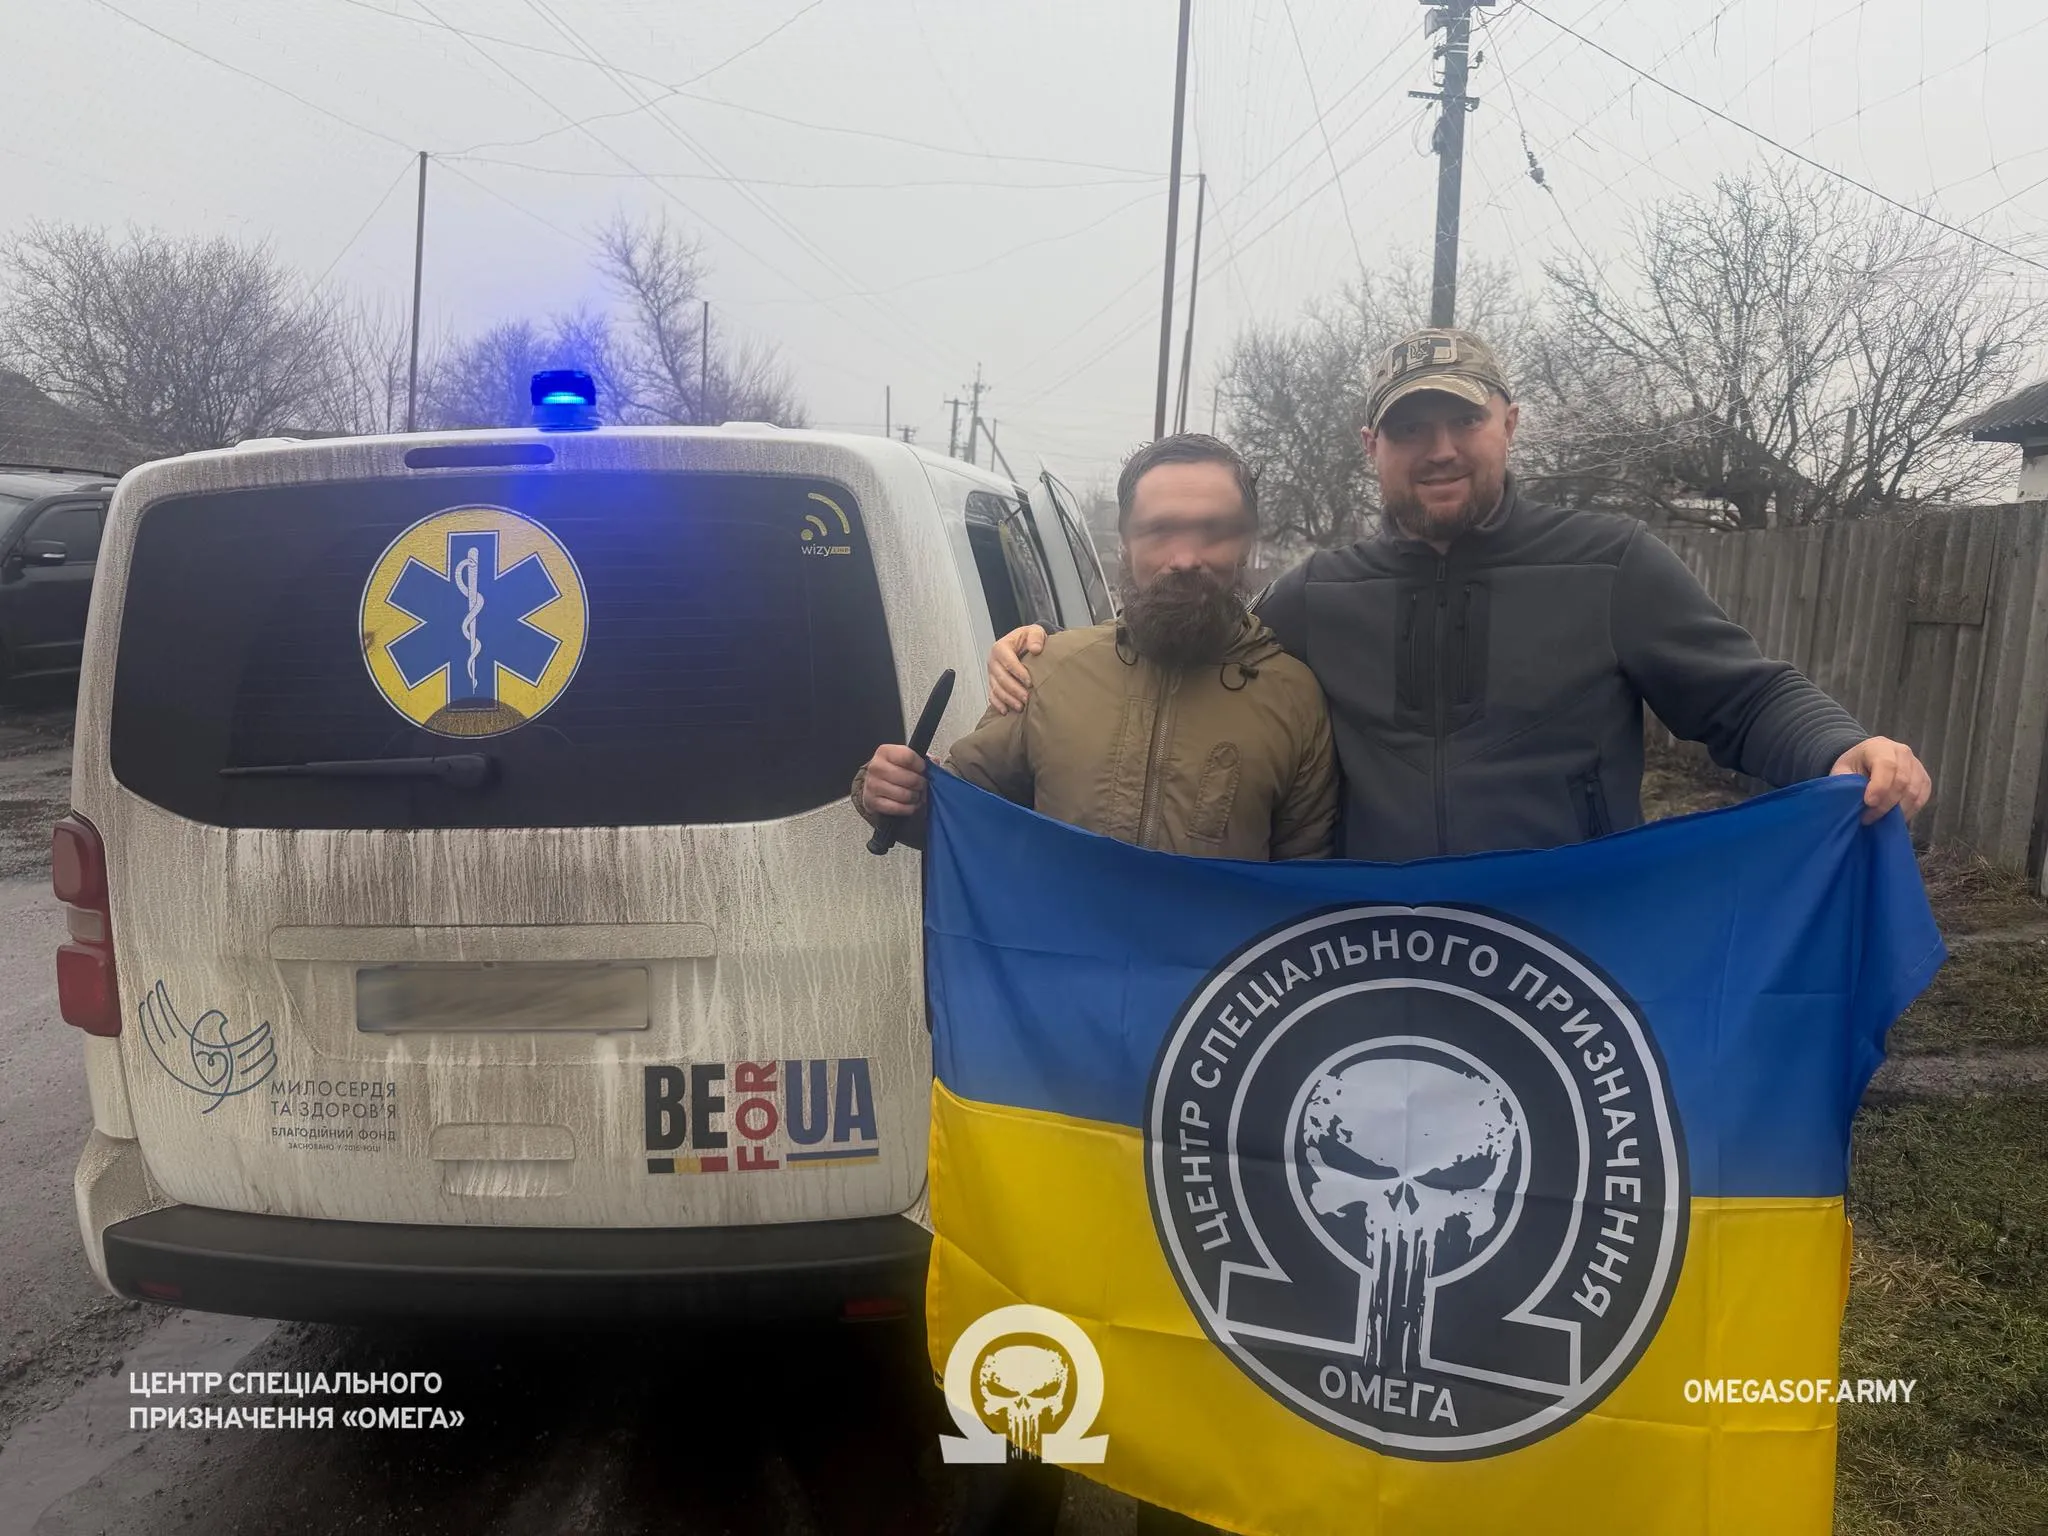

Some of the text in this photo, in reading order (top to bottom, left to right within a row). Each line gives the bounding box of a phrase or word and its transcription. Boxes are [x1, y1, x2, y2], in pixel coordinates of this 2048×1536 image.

[801, 543, 831, 557] wizy
[271, 1079, 397, 1101] МИЛОСЕРДЯ
[271, 1100, 293, 1117] ТА
[644, 1057, 878, 1171] BE FOR UA
[271, 1126, 397, 1142] БЛАГОДІЙНИЙ ФОНД
[1179, 928, 1642, 1319] ЦЕНТР СПЕЦІАЛЬНОГО ПРИЗНАЧЕННЯ
[1319, 1365, 1460, 1428] ОМЕГА
